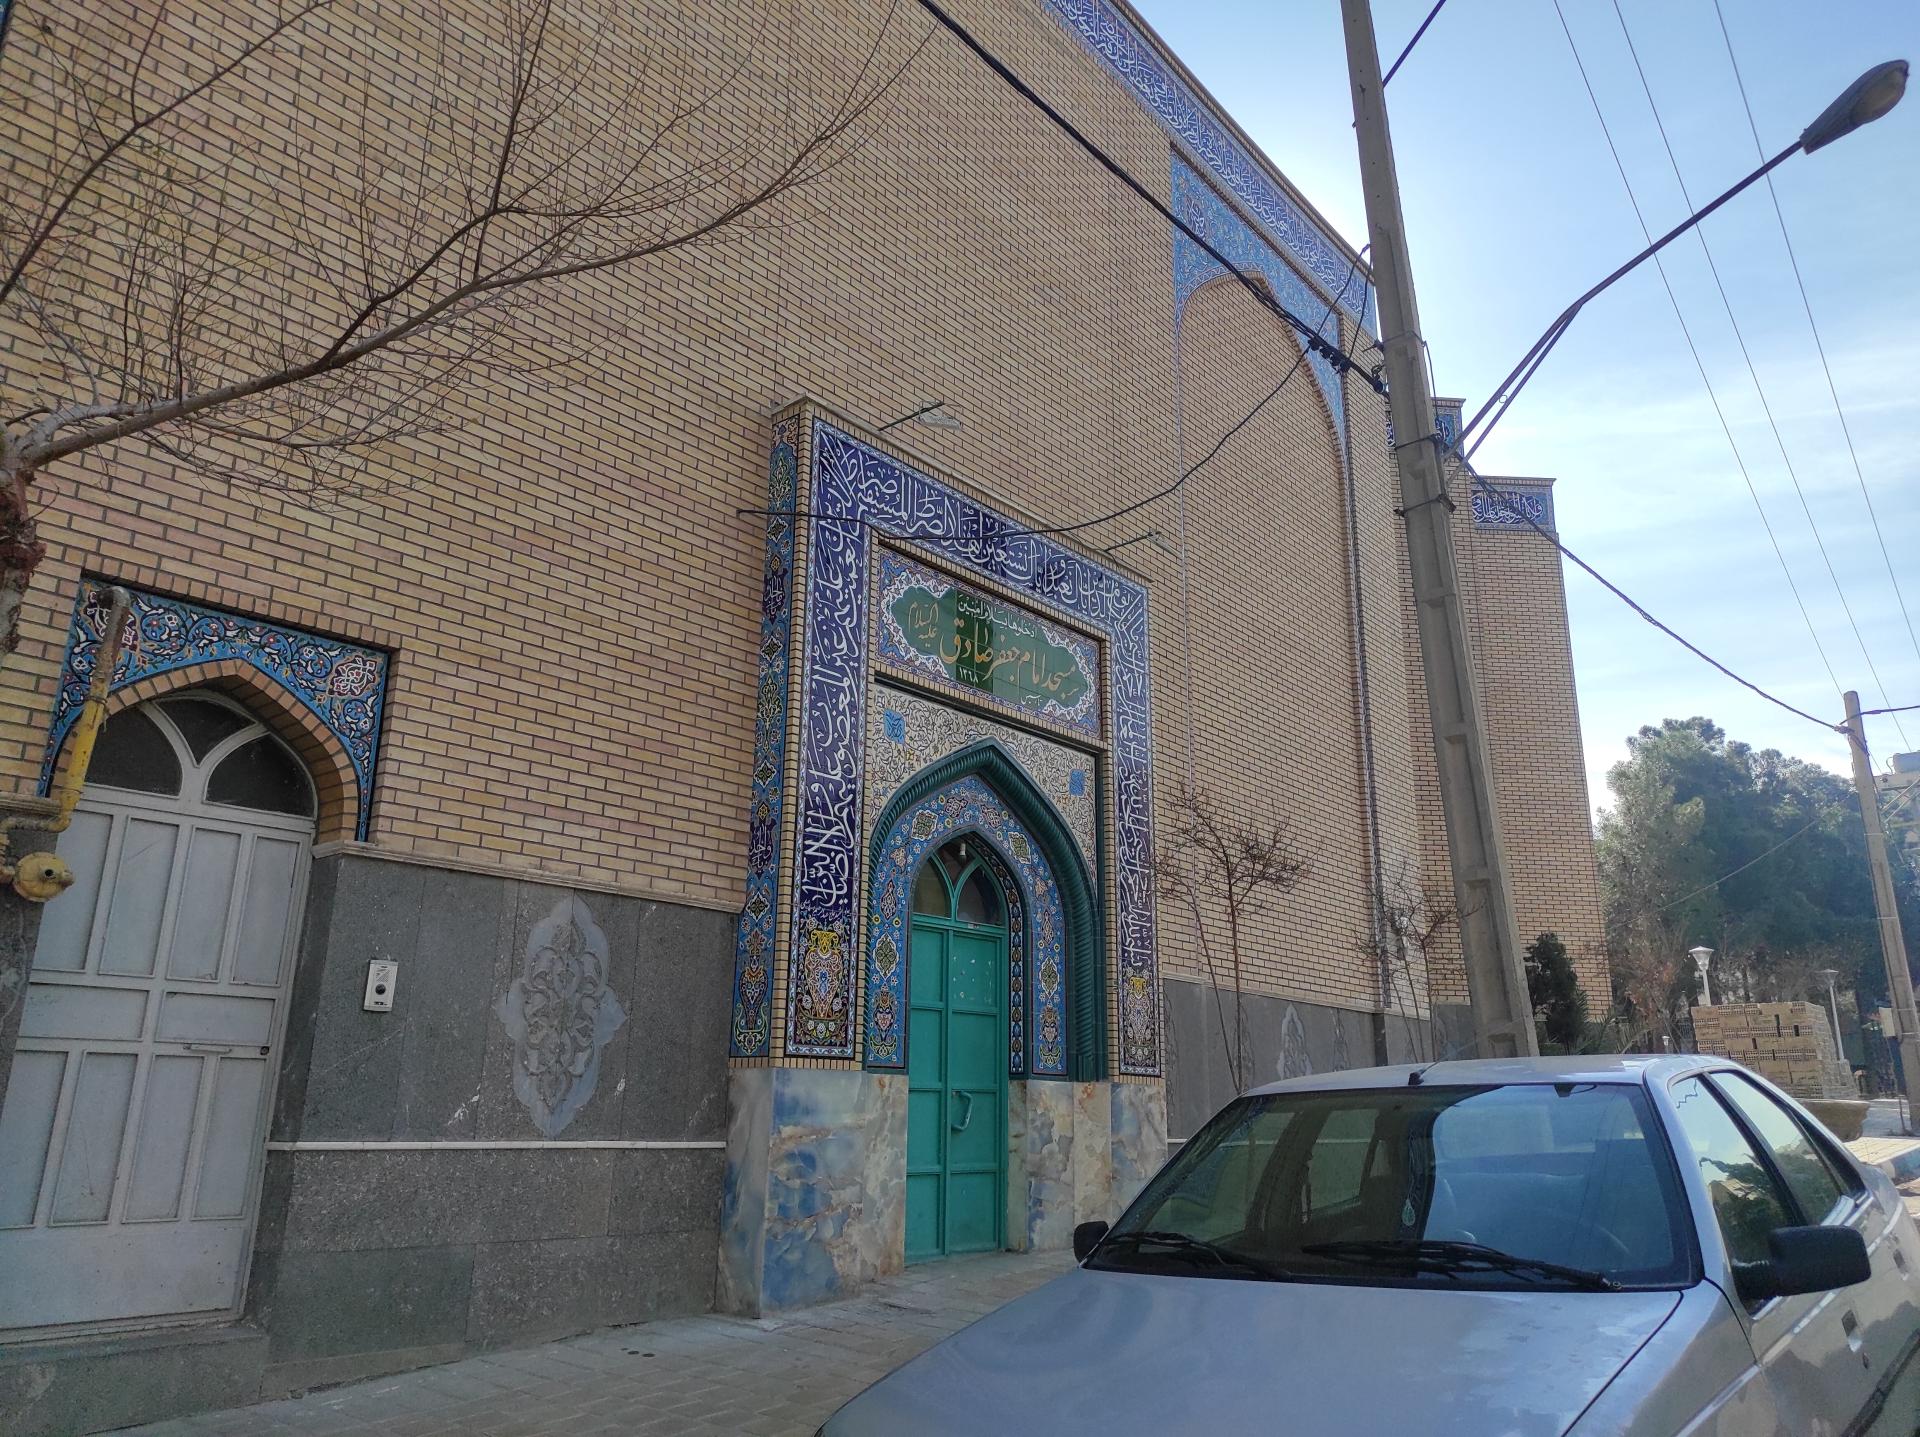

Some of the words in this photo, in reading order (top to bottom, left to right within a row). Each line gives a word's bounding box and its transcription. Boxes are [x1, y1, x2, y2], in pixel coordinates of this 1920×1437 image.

[940, 617, 994, 664] صادق
[982, 635, 1019, 682] جعفر
[1018, 650, 1045, 688] امام
[1041, 664, 1077, 699] مسجد
